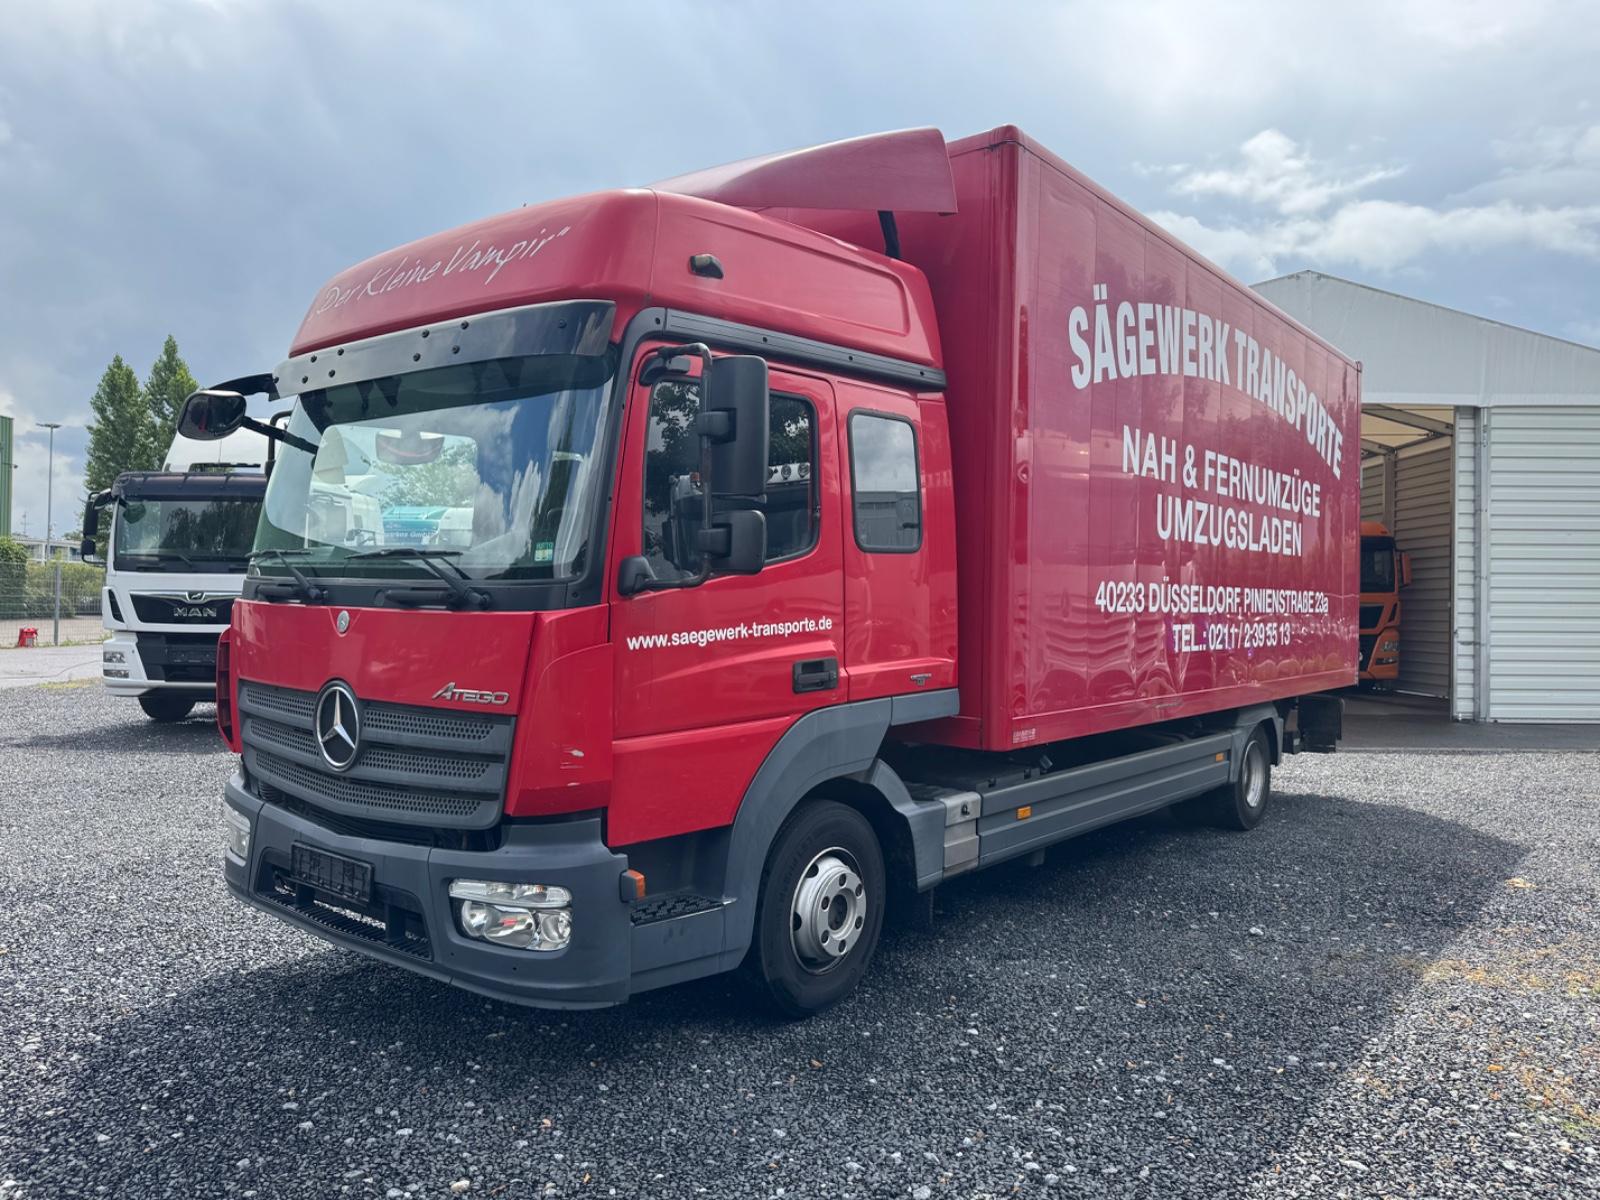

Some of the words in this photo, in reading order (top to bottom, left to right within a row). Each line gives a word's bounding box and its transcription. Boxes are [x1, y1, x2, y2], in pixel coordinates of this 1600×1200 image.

[357, 256, 441, 300] Kleine
[1068, 283, 1230, 390] SÄGEWERK
[1235, 328, 1343, 480] TRANSPORTE
[1122, 424, 1177, 483] NAH
[1182, 444, 1198, 488] &
[1204, 449, 1321, 517] FERNUMZÜGE
[1156, 493, 1302, 556] UMZUGSLADEN
[173, 607, 217, 617] MAN
[1095, 580, 1145, 613] 40233
[627, 616, 833, 650] www.saegewerk-transporte.de
